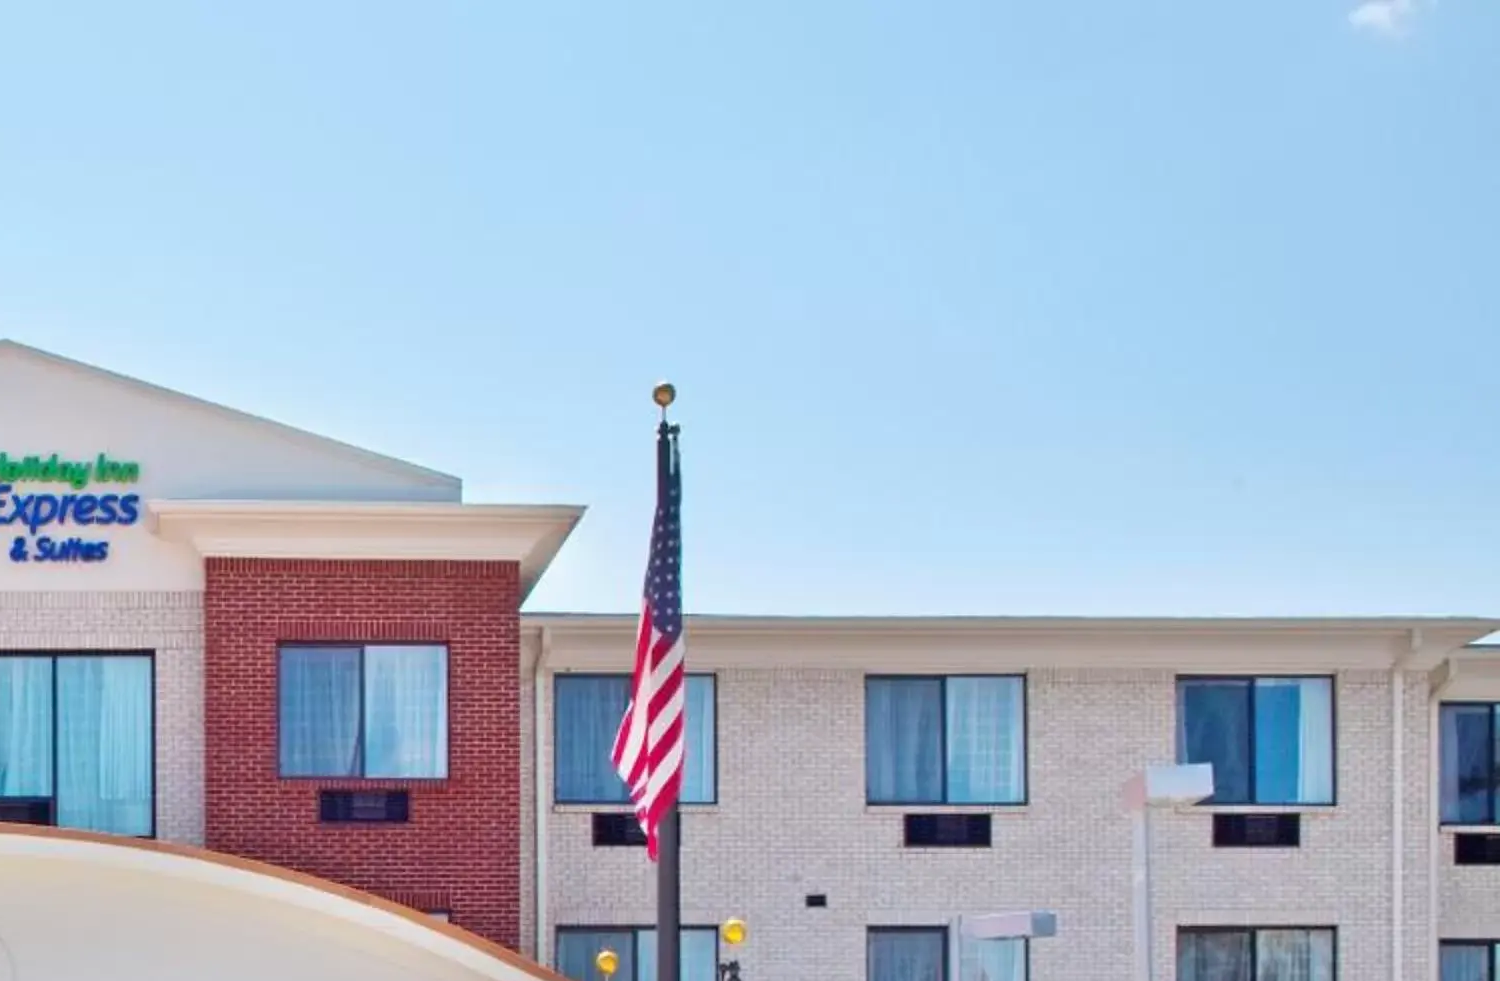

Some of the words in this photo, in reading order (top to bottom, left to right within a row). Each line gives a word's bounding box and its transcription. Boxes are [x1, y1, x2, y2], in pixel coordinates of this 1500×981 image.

[95, 452, 140, 483] Inn
[10, 536, 28, 562] &
[33, 537, 109, 562] Suites
